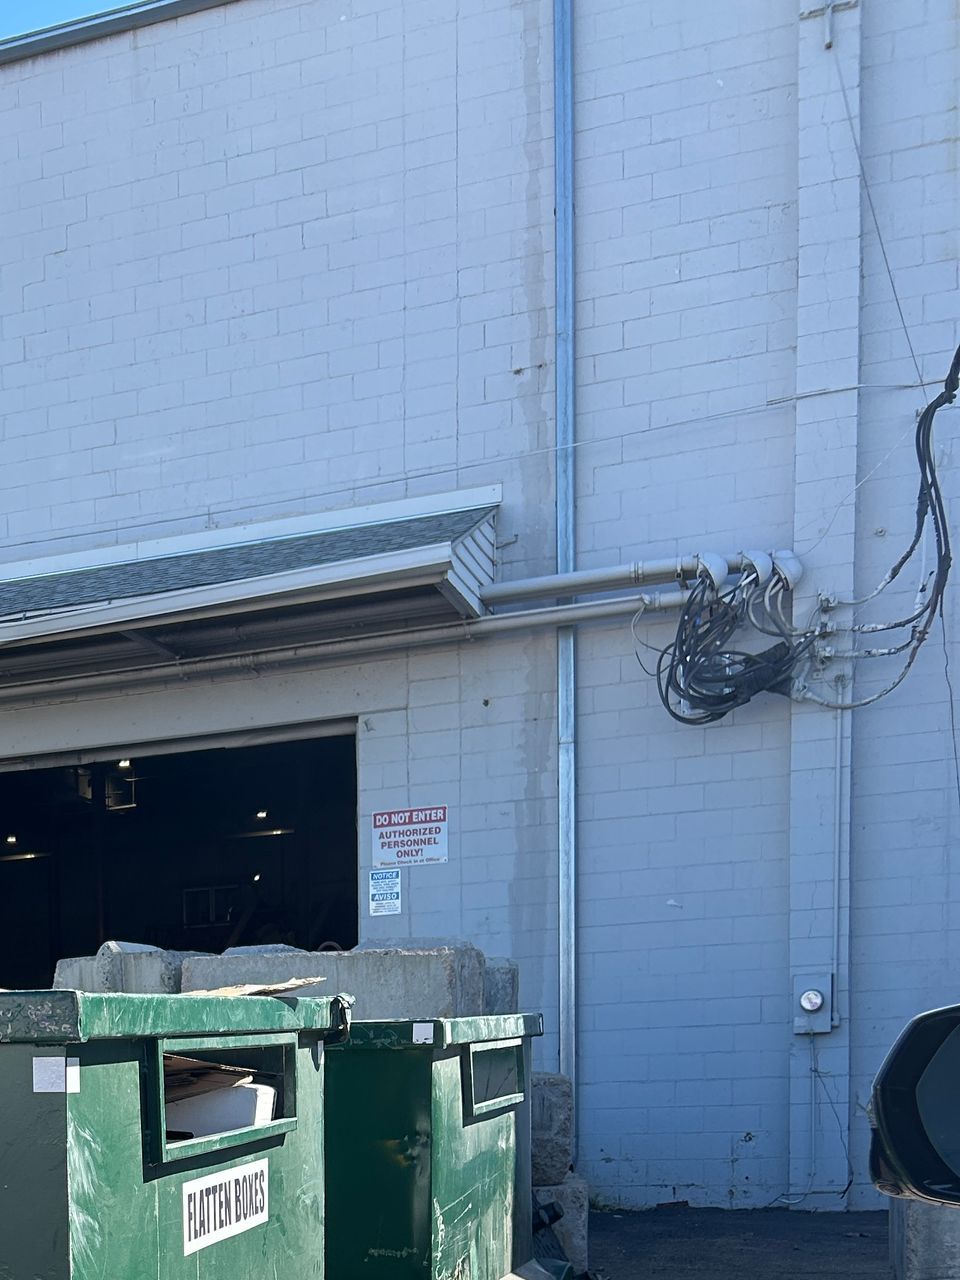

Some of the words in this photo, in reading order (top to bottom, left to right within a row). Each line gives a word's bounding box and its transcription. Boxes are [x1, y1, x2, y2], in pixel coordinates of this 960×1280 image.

[376, 815, 389, 826] DO
[391, 812, 410, 824] NOT
[412, 809, 444, 822] ENTER
[379, 827, 442, 840] AUTHORIZED
[381, 837, 439, 850] PERSONNEL
[396, 848, 424, 859] ONLY!
[372, 872, 398, 880] NOTICE
[374, 893, 397, 901] AVISO
[187, 1180, 232, 1242] FLATTEN
[234, 1169, 266, 1223] BOXES
